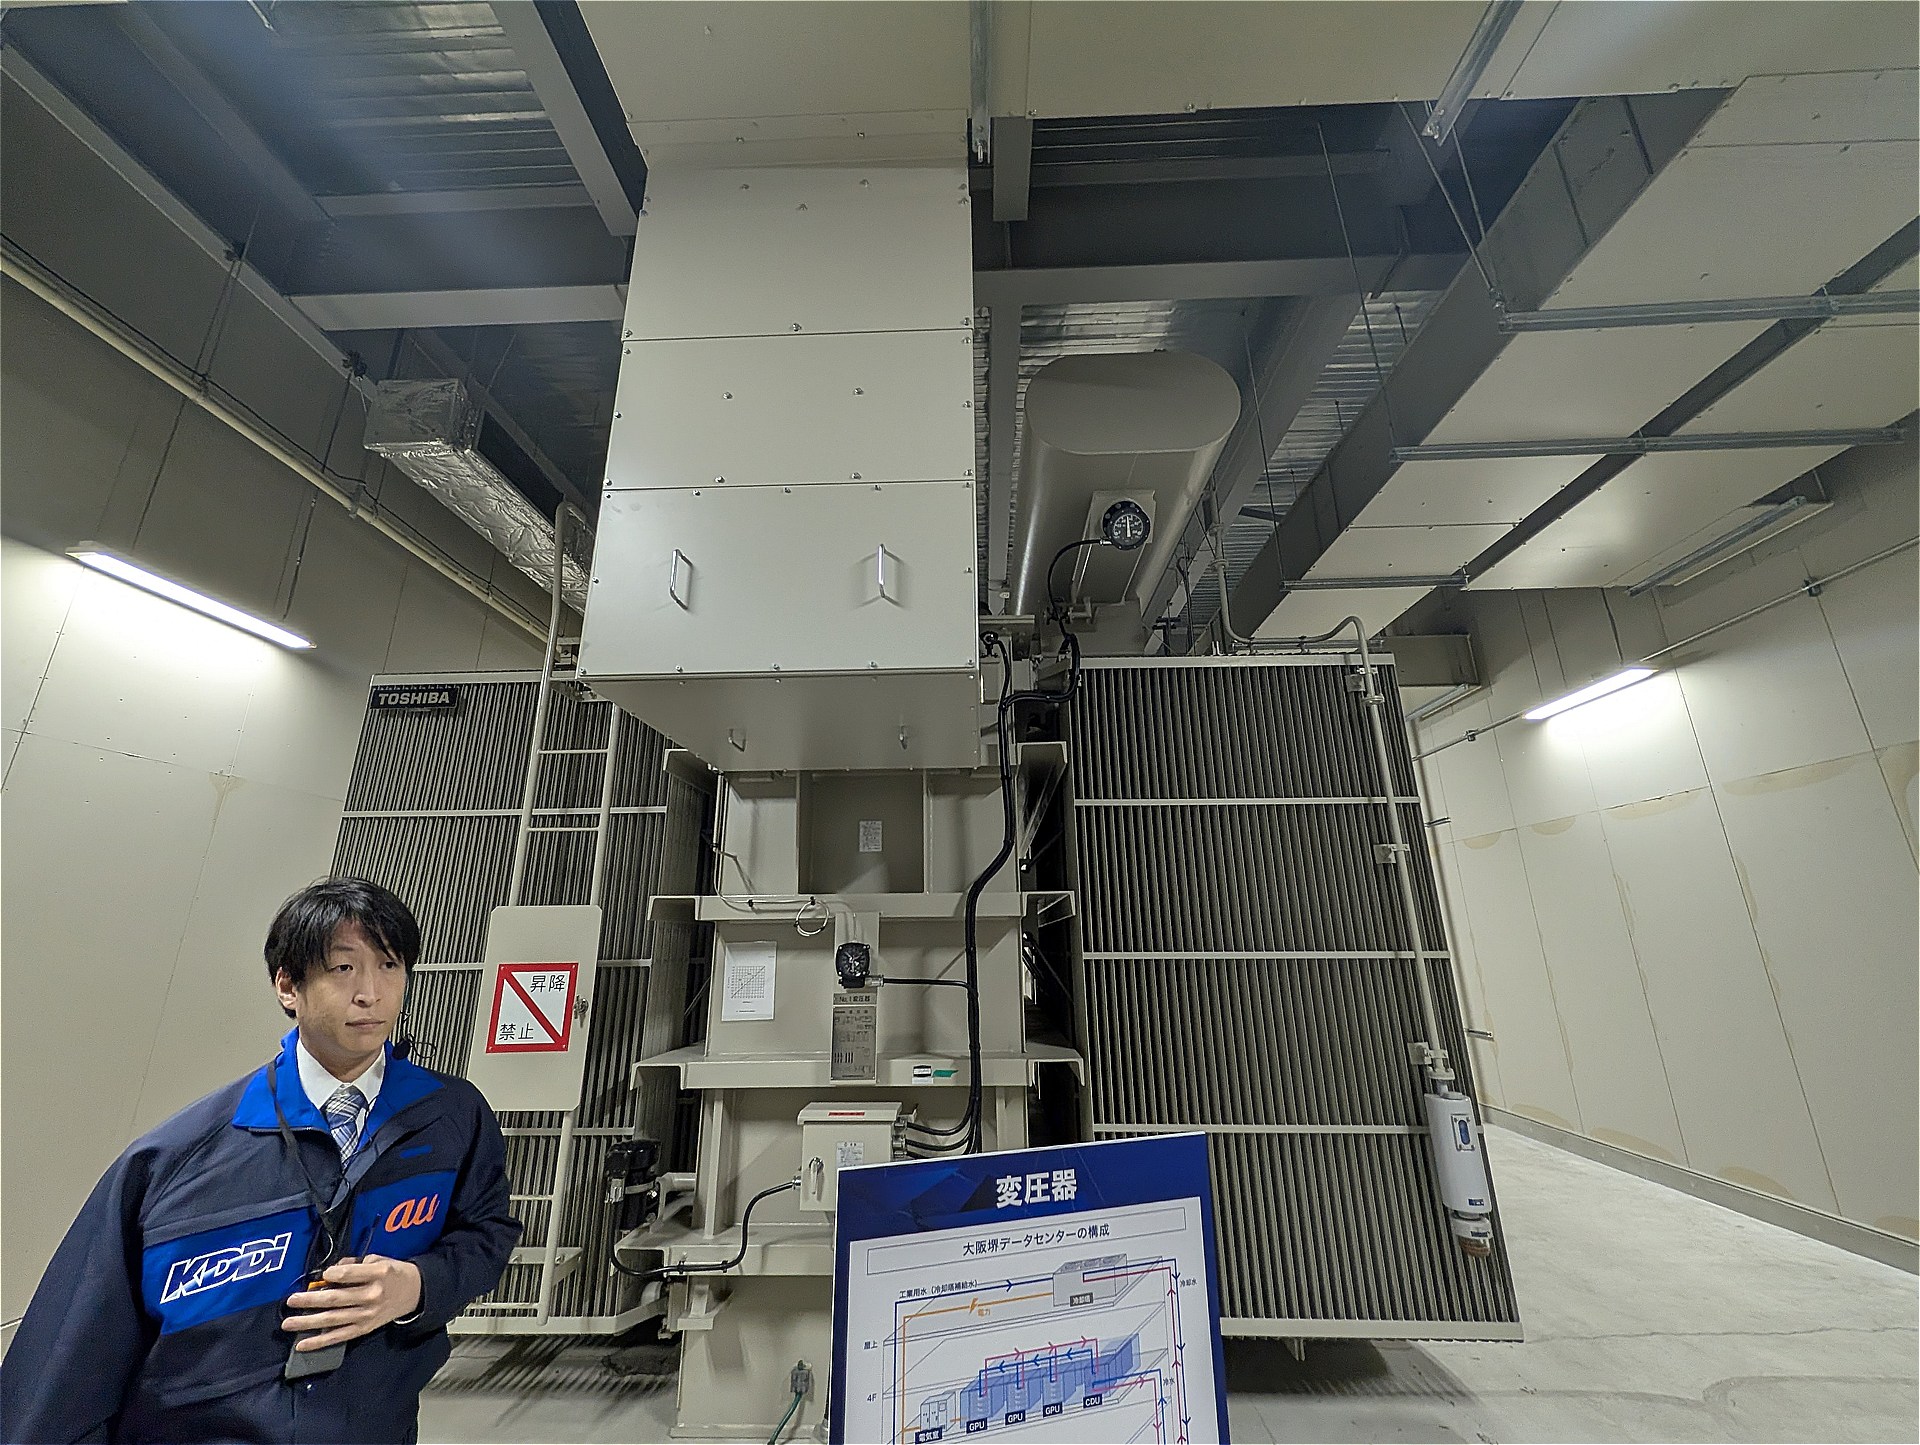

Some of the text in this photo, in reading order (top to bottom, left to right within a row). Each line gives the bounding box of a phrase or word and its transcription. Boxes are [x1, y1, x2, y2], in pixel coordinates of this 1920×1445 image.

[378, 691, 450, 705] TOSHIBA
[530, 974, 566, 992] 昇降
[498, 1022, 534, 1041] 禁止
[996, 1168, 1077, 1209] 変圧器
[384, 1193, 440, 1233] au
[962, 1223, 1110, 1257] 大阪堺データセンターの構成
[160, 1231, 292, 1304] KDDI
[866, 1393, 877, 1402] 4F
[1085, 1395, 1101, 1407] CDU
[1007, 1411, 1024, 1423] GPU
[1045, 1404, 1061, 1415] GPU
[968, 1419, 986, 1431] GPU
